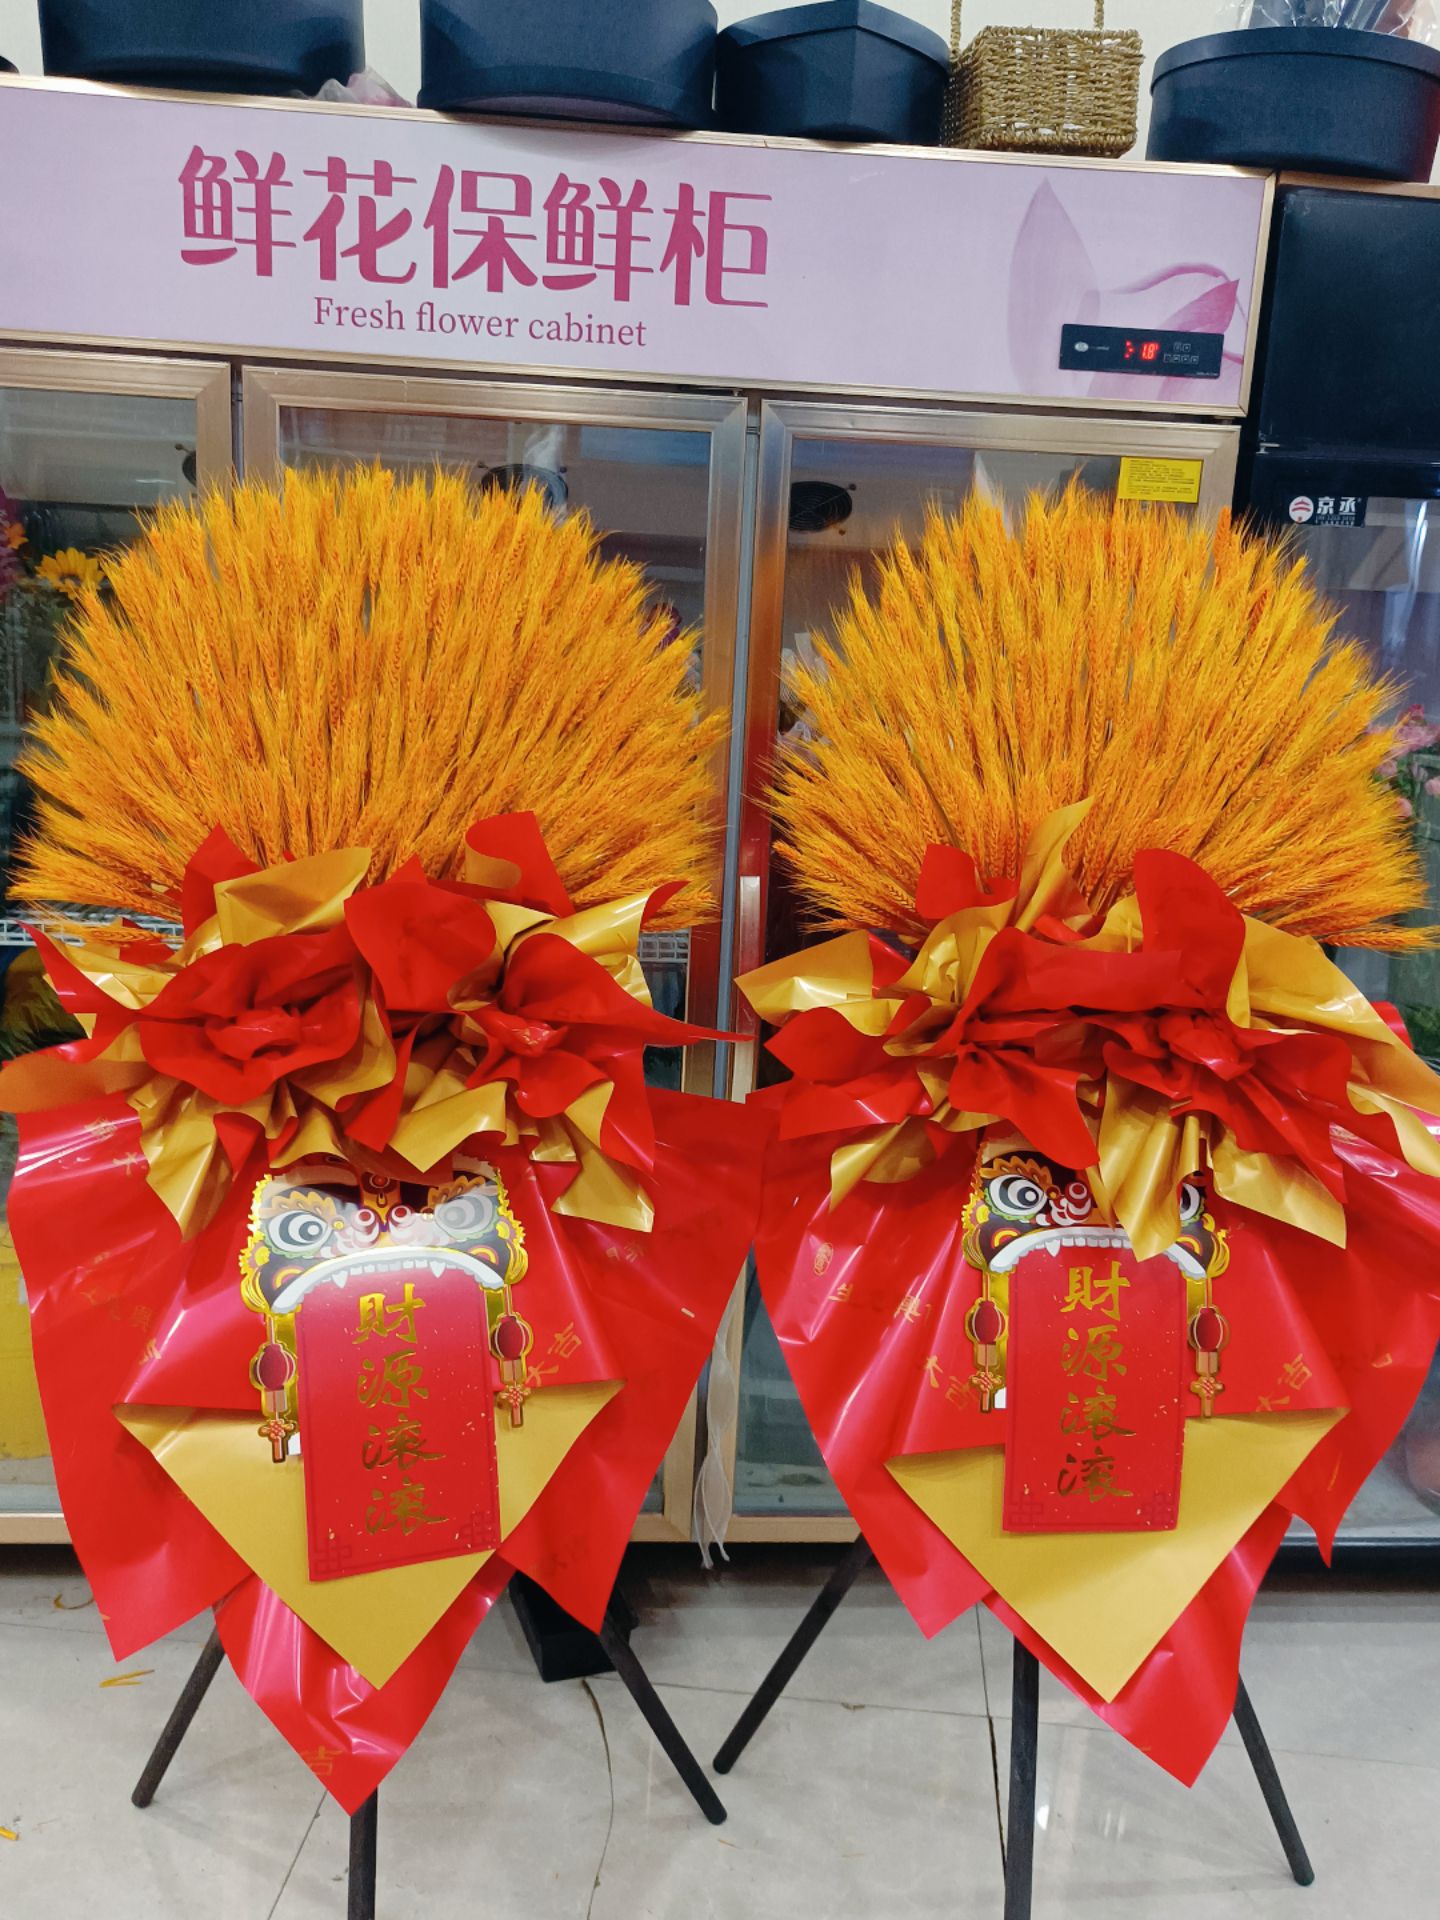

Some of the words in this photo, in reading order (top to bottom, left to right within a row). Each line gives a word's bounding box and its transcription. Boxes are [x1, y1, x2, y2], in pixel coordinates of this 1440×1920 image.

[176, 144, 773, 309] 鲜花保鲜柜
[314, 297, 405, 331] Fresh
[416, 301, 519, 338] flower
[528, 312, 646, 347] cabinet
